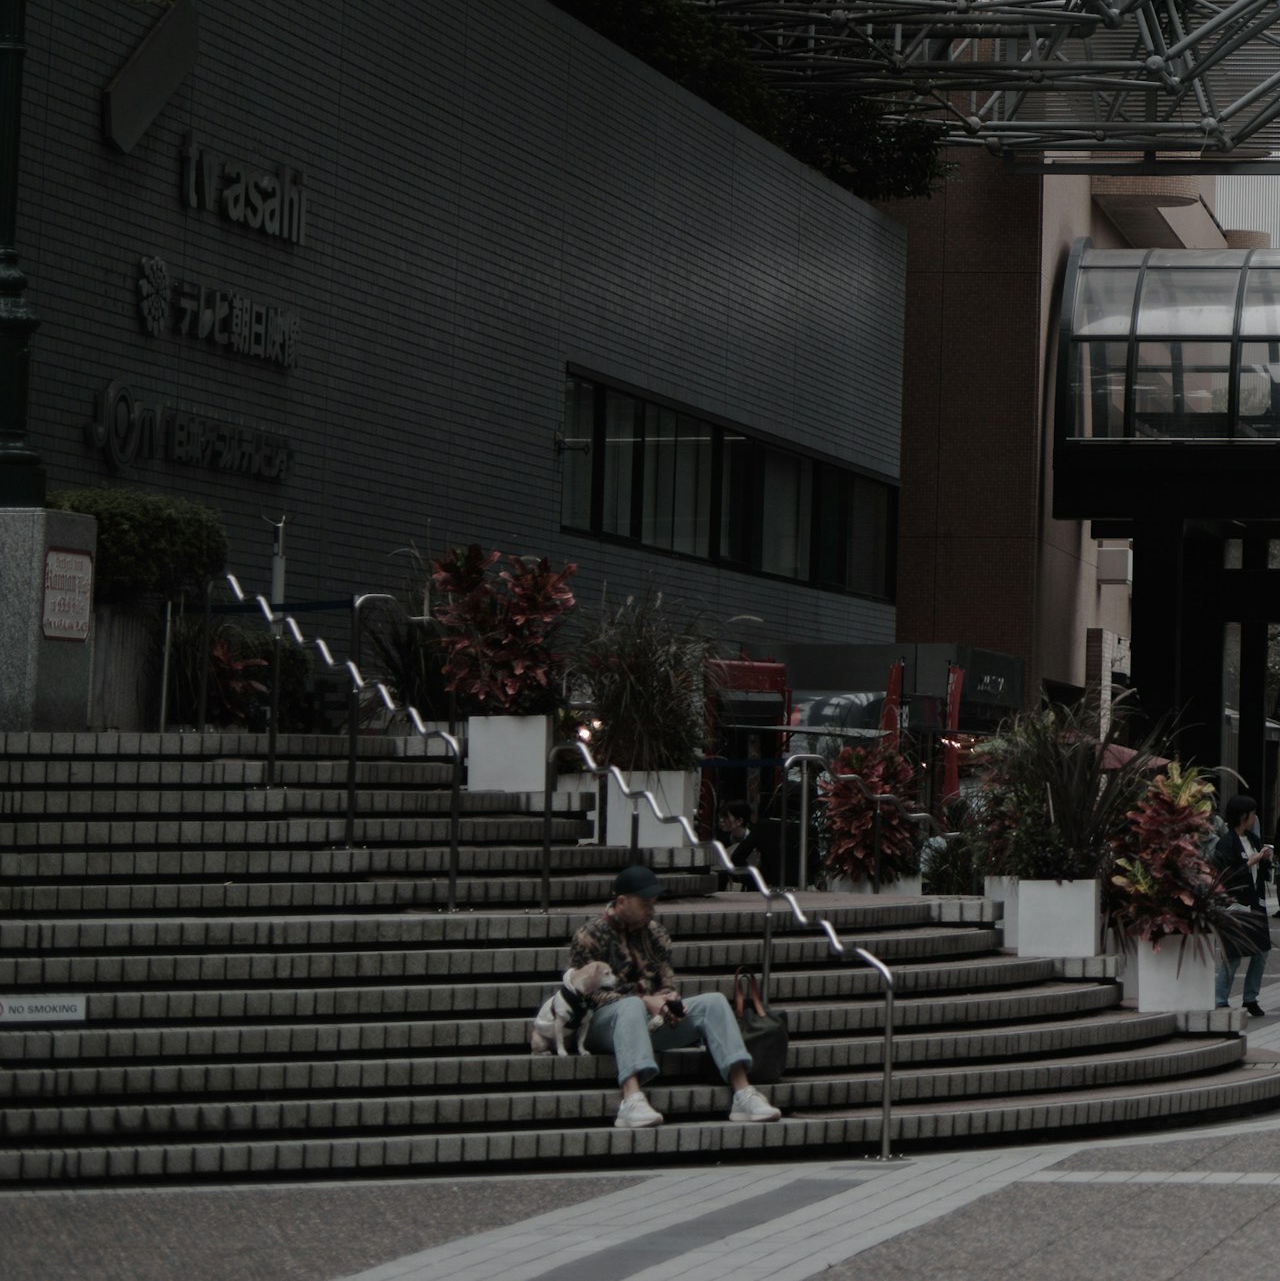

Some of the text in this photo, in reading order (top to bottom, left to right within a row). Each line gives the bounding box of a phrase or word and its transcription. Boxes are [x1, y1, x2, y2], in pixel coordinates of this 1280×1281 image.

[222, 161, 307, 246] asahi
[178, 282, 300, 369] テレビ朝日映像
[8, 1004, 78, 1015] NO SMOKING
